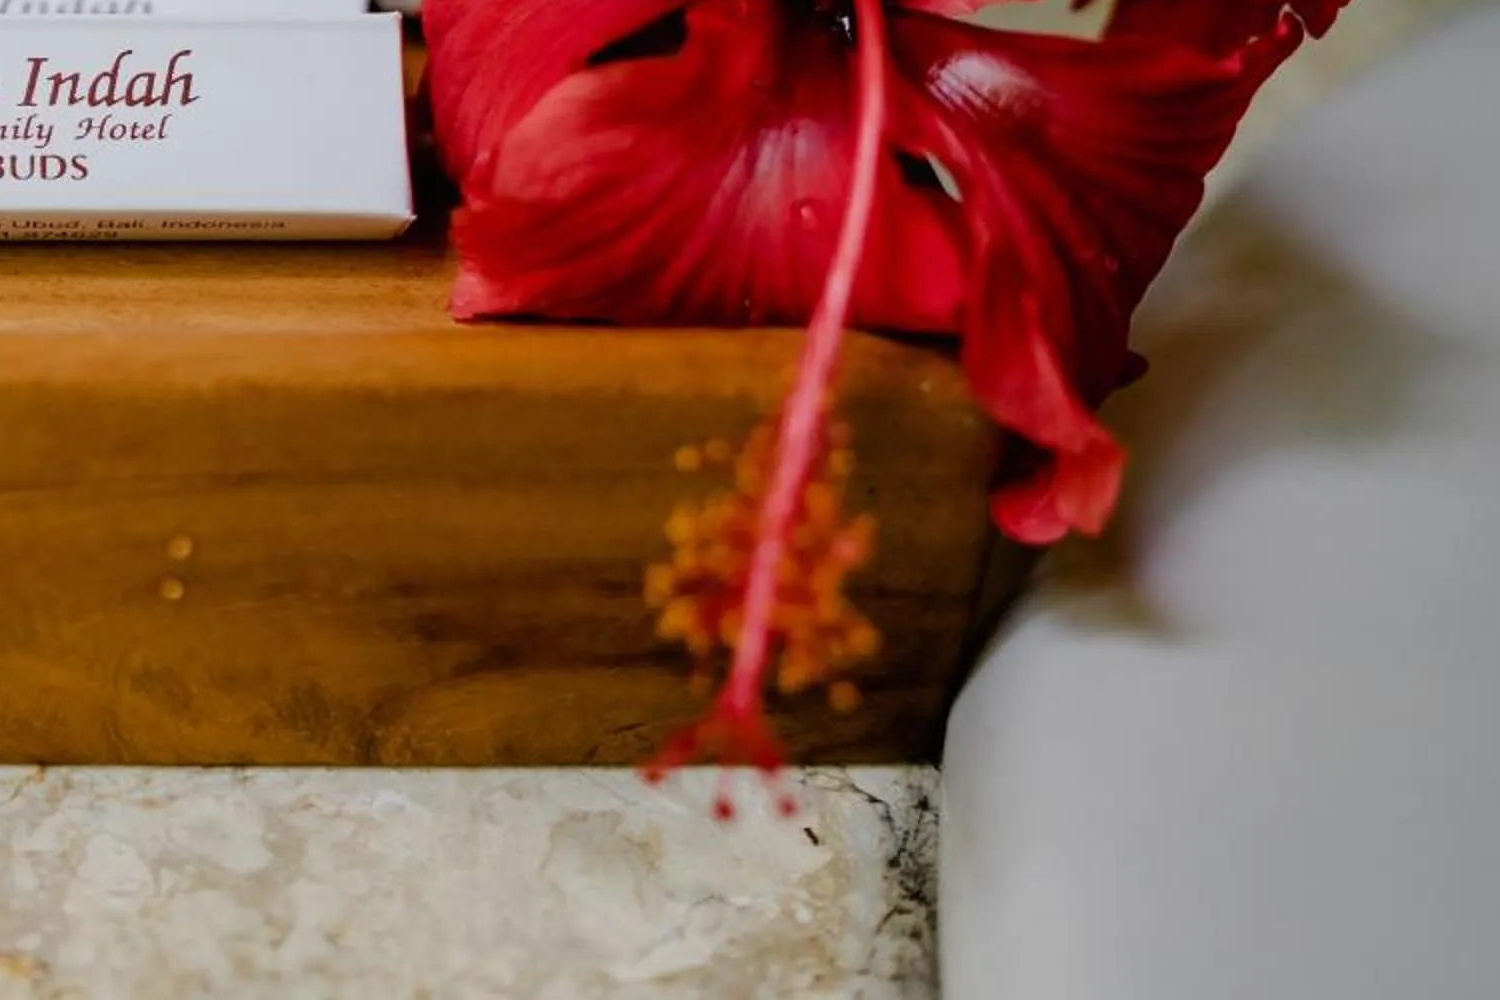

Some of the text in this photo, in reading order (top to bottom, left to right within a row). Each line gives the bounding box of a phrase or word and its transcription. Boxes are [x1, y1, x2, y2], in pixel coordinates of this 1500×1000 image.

[15, 49, 201, 108] Indah
[75, 113, 174, 142] Hotel
[160, 219, 286, 230] Indonesia
